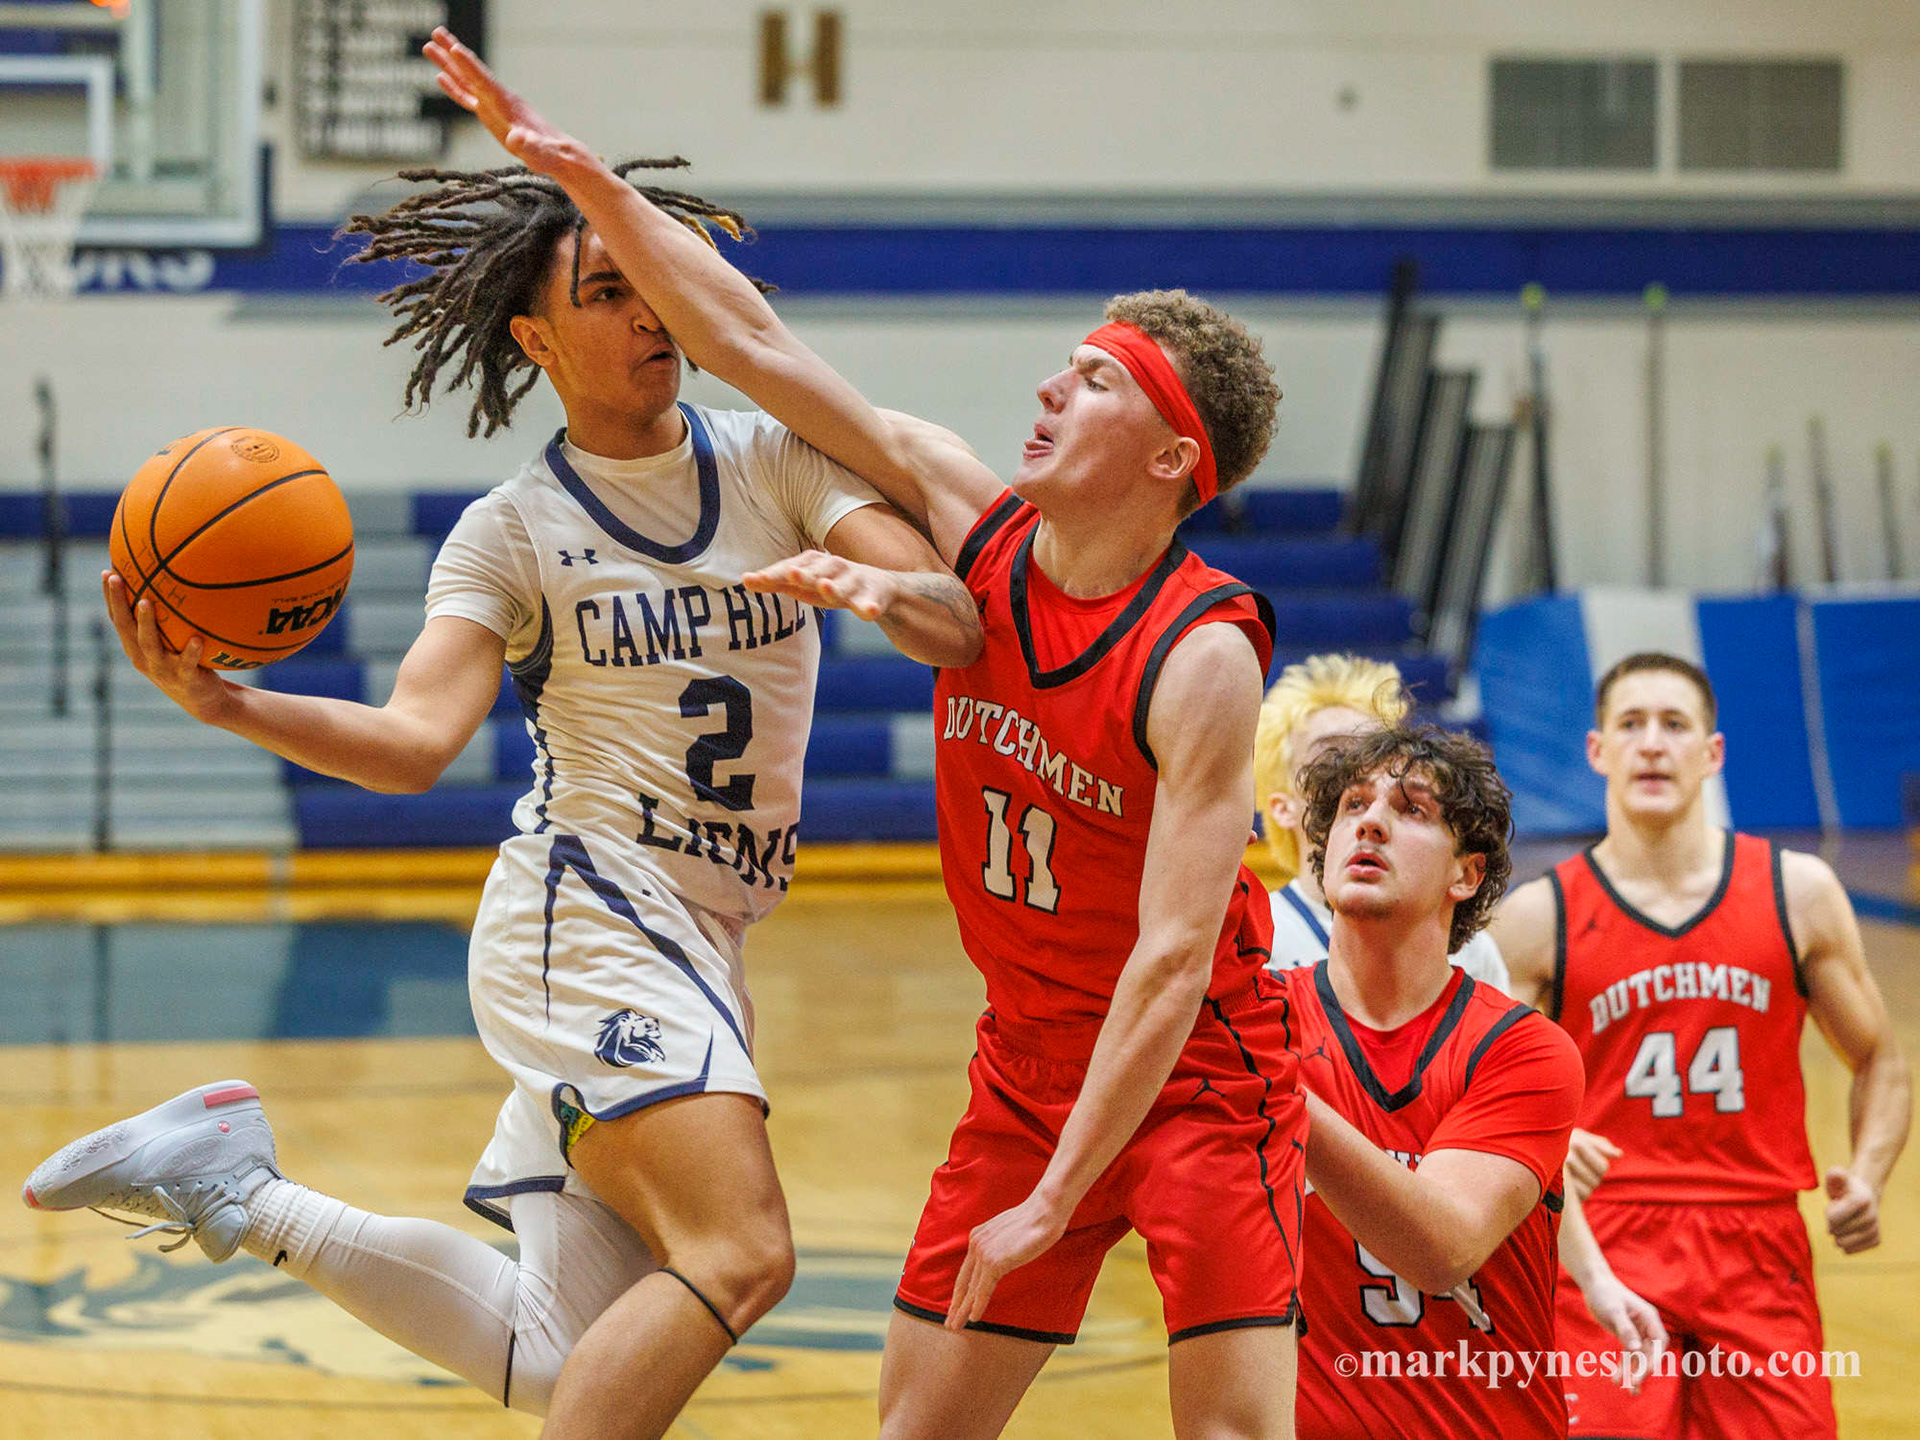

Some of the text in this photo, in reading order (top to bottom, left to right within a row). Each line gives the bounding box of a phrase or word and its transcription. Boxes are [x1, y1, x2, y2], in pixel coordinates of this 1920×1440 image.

[575, 583, 807, 667] CAMP HILL
[678, 675, 756, 811] 2
[943, 696, 1124, 818] DUTCHMEN
[981, 785, 1061, 916] 11
[1589, 961, 1771, 1035] DUTCHMEN
[1624, 1026, 1745, 1118] 44
